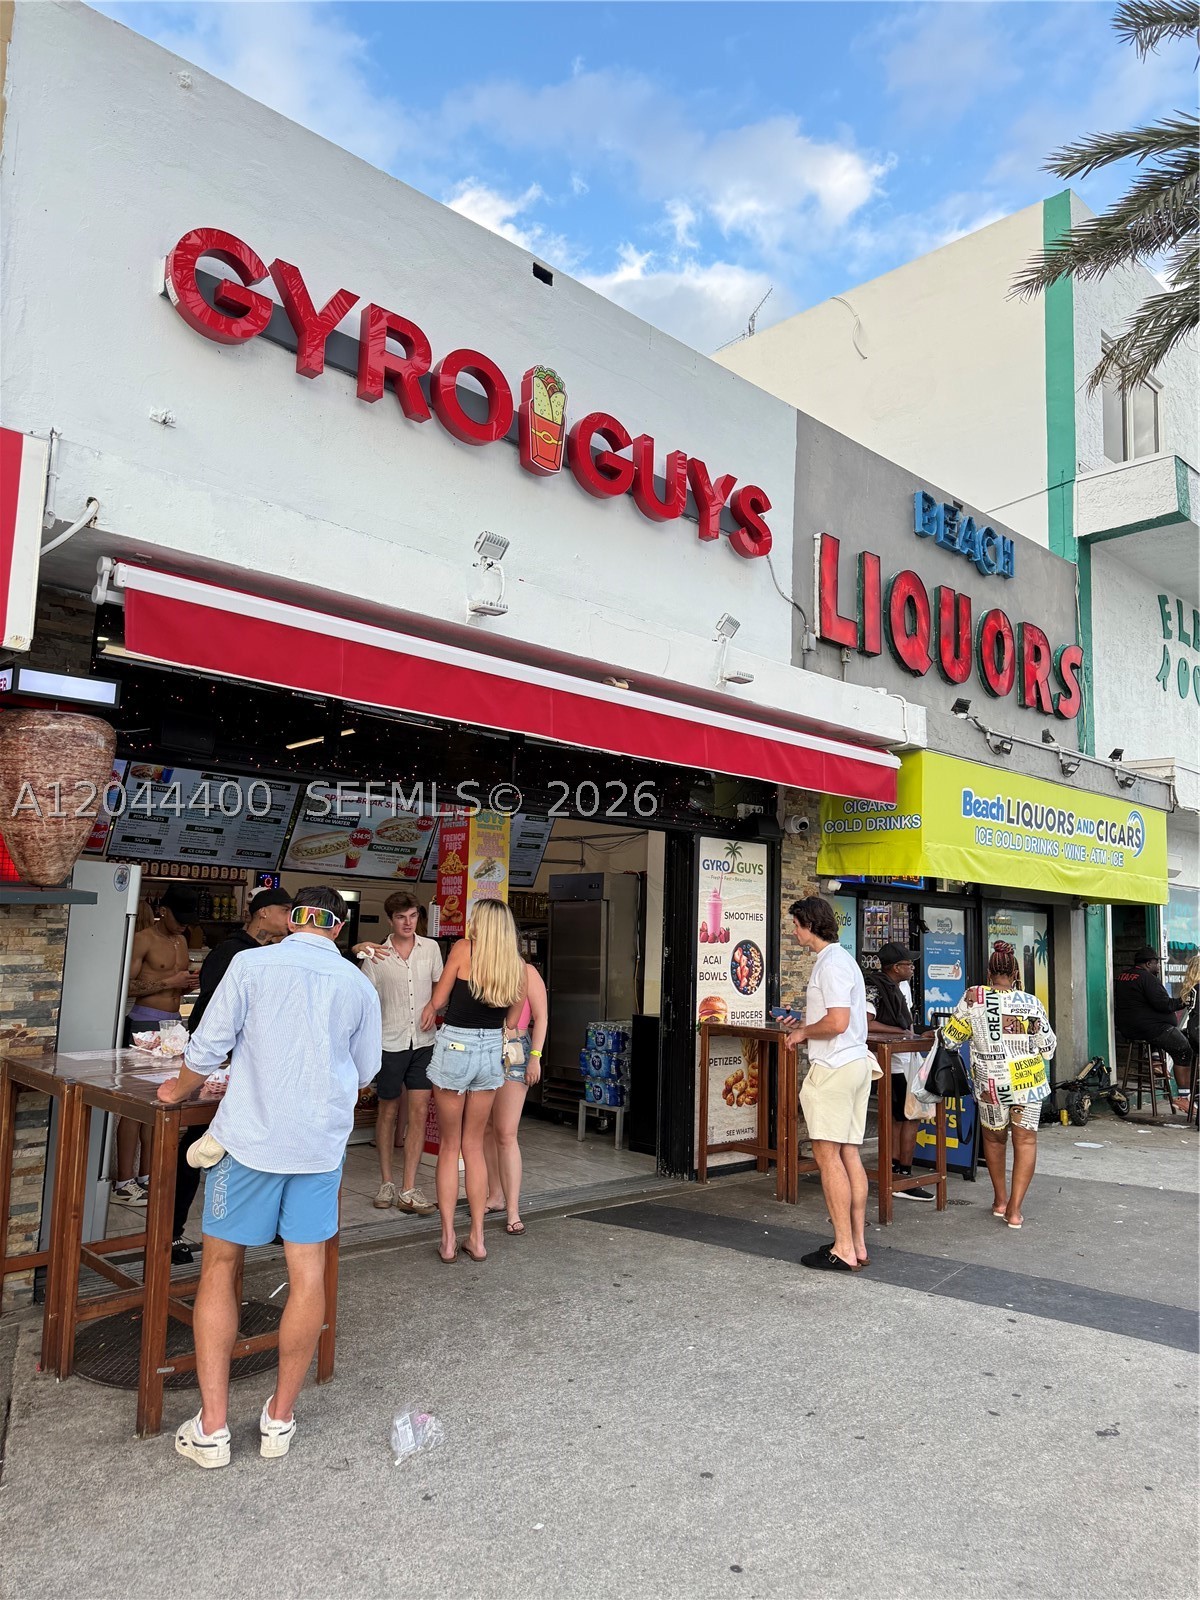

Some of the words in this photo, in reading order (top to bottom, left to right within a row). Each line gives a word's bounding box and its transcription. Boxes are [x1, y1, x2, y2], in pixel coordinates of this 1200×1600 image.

[164, 227, 513, 446] GYRO
[567, 412, 773, 560] GUYS
[913, 490, 1015, 579] BEACH
[813, 532, 1084, 720] LIQUORS
[962, 788, 1005, 823] Beach
[1006, 797, 1076, 836] LIQUORS
[1076, 818, 1096, 836] AND
[1096, 818, 1142, 849] CIGARS
[824, 820, 864, 834] COLD
[866, 814, 922, 832] DRINKS
[443, 832, 465, 842] FRENCH
[445, 841, 462, 850] FRIES
[975, 825, 994, 846] ICE
[995, 829, 1024, 851] COLD
[1024, 834, 1060, 858] DRINKS
[1064, 842, 1087, 862] WINE
[1089, 847, 1108, 865] ATM
[1110, 850, 1124, 868] ICE
[702, 859, 726, 872] GYRO
[736, 861, 760, 875] GUYS
[441, 876, 462, 886] ONION
[442, 885, 462, 895] RINGS
[724, 911, 764, 922] SMOOTHIES
[703, 955, 722, 965] ACAI
[699, 971, 728, 981] BOWLS
[1118, 972, 1140, 981] STAFF
[730, 1010, 763, 1020] BURGERS
[735, 1127, 755, 1135] WHAT'S
[212, 1154, 233, 1220] ONES
